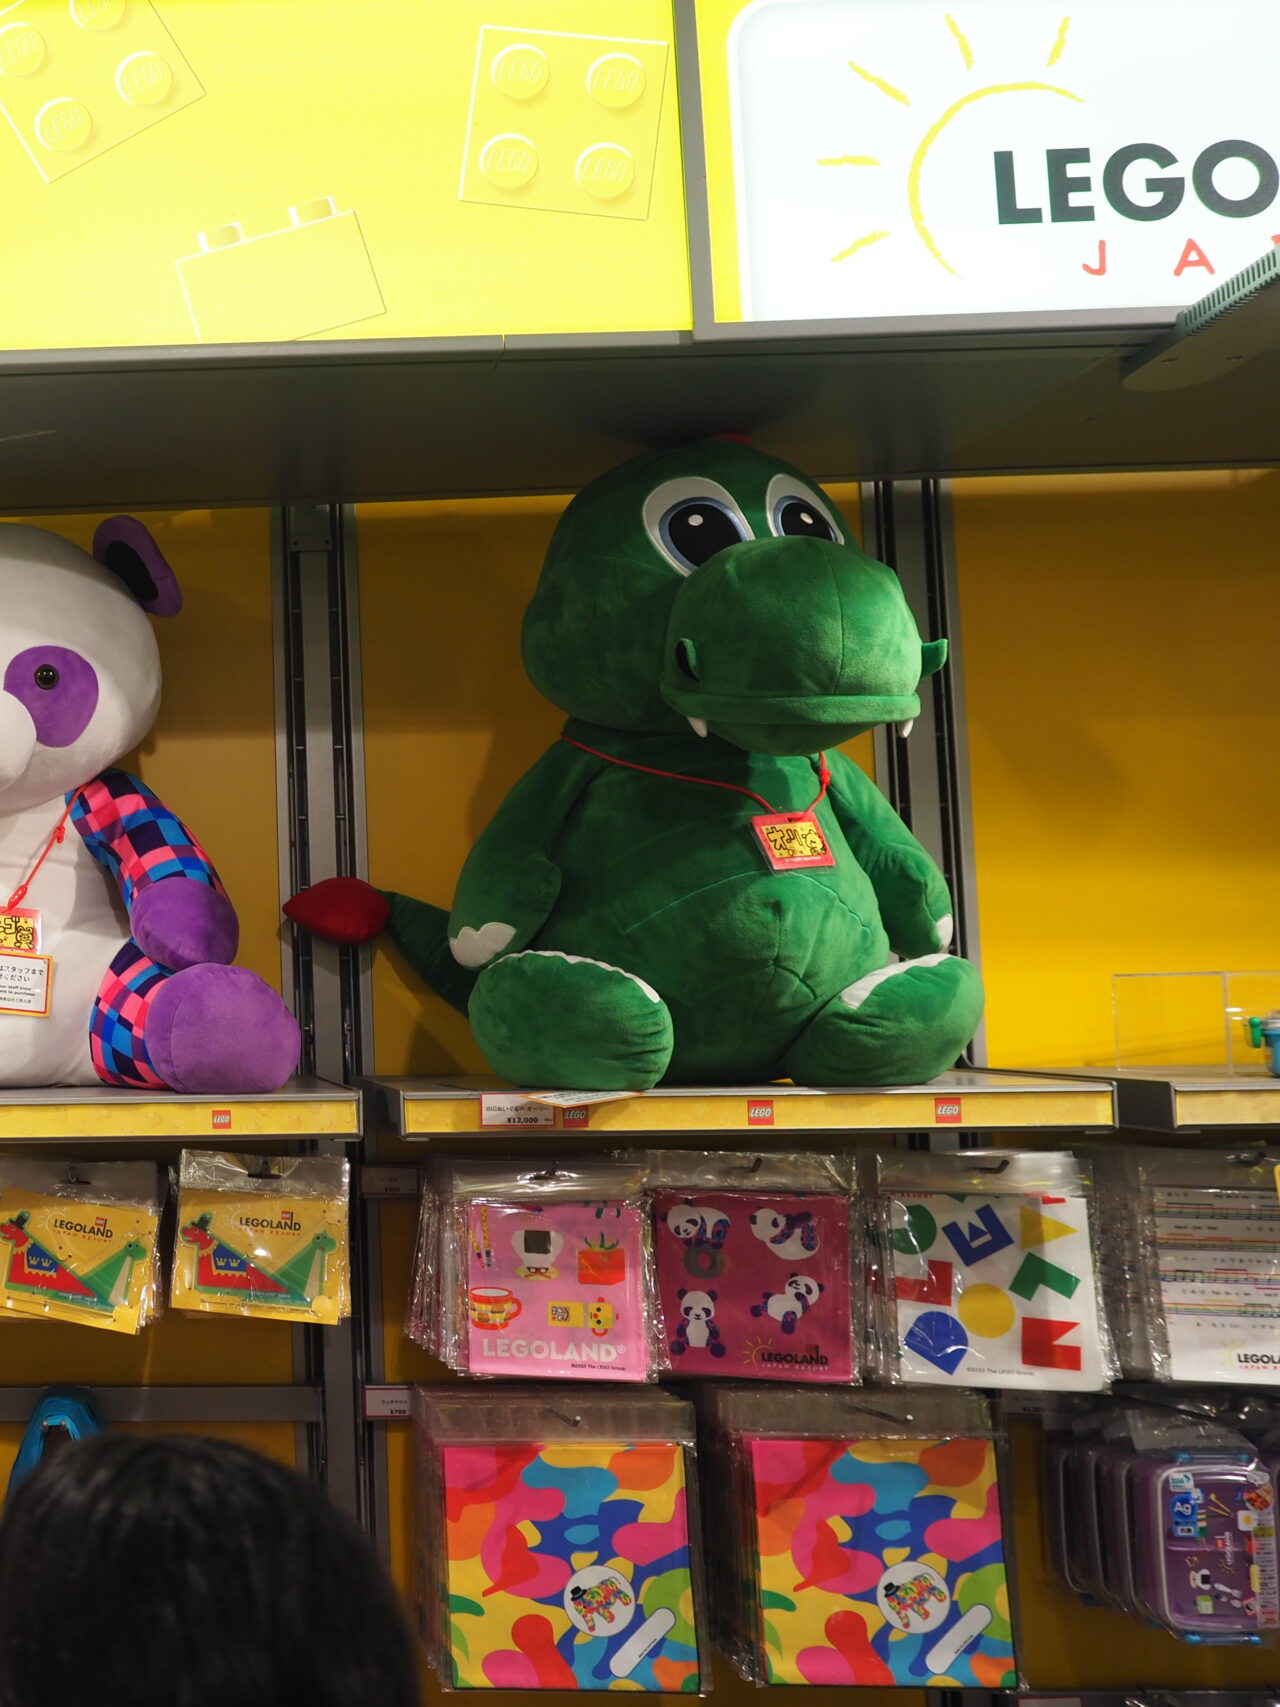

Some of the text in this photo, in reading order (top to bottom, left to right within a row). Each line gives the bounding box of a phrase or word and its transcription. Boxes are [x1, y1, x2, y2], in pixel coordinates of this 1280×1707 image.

[1082, 234, 1280, 276] JA
[565, 1110, 586, 1120] LEGO
[750, 1107, 771, 1117] LEGO
[937, 1105, 959, 1115] LEGO
[54, 1218, 113, 1238] LEGOLAND
[240, 1212, 302, 1231] LEGOLAND
[483, 1338, 617, 1362] LEGOLAND
[761, 1344, 828, 1364] LEGOLAND
[1237, 1353, 1280, 1364] LEGOL
[1174, 1502, 1192, 1515] Ag
